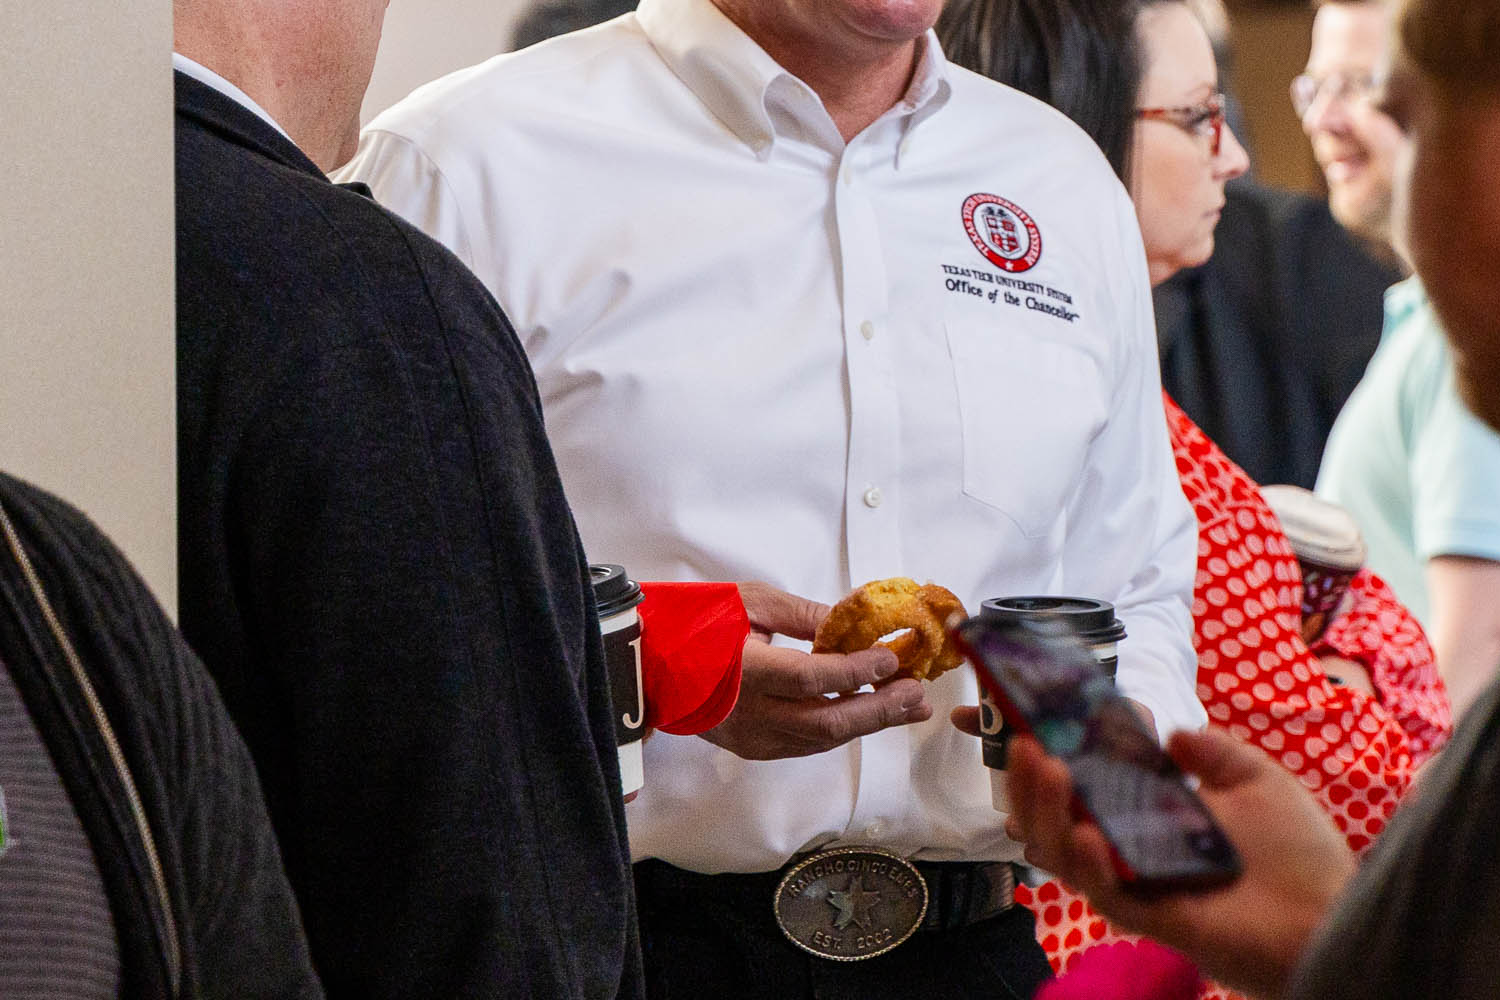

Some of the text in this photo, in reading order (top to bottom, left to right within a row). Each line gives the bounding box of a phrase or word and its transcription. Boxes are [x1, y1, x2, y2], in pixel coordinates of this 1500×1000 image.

[941, 264, 971, 277] TEXAS
[971, 269, 994, 283] TECH
[995, 275, 1044, 295] UNIVERSITY
[945, 278, 1080, 322] Office of the Chancellor
[787, 860, 844, 897] RANCHO
[847, 860, 887, 874] CINCO
[813, 928, 893, 950] EST. 2002
